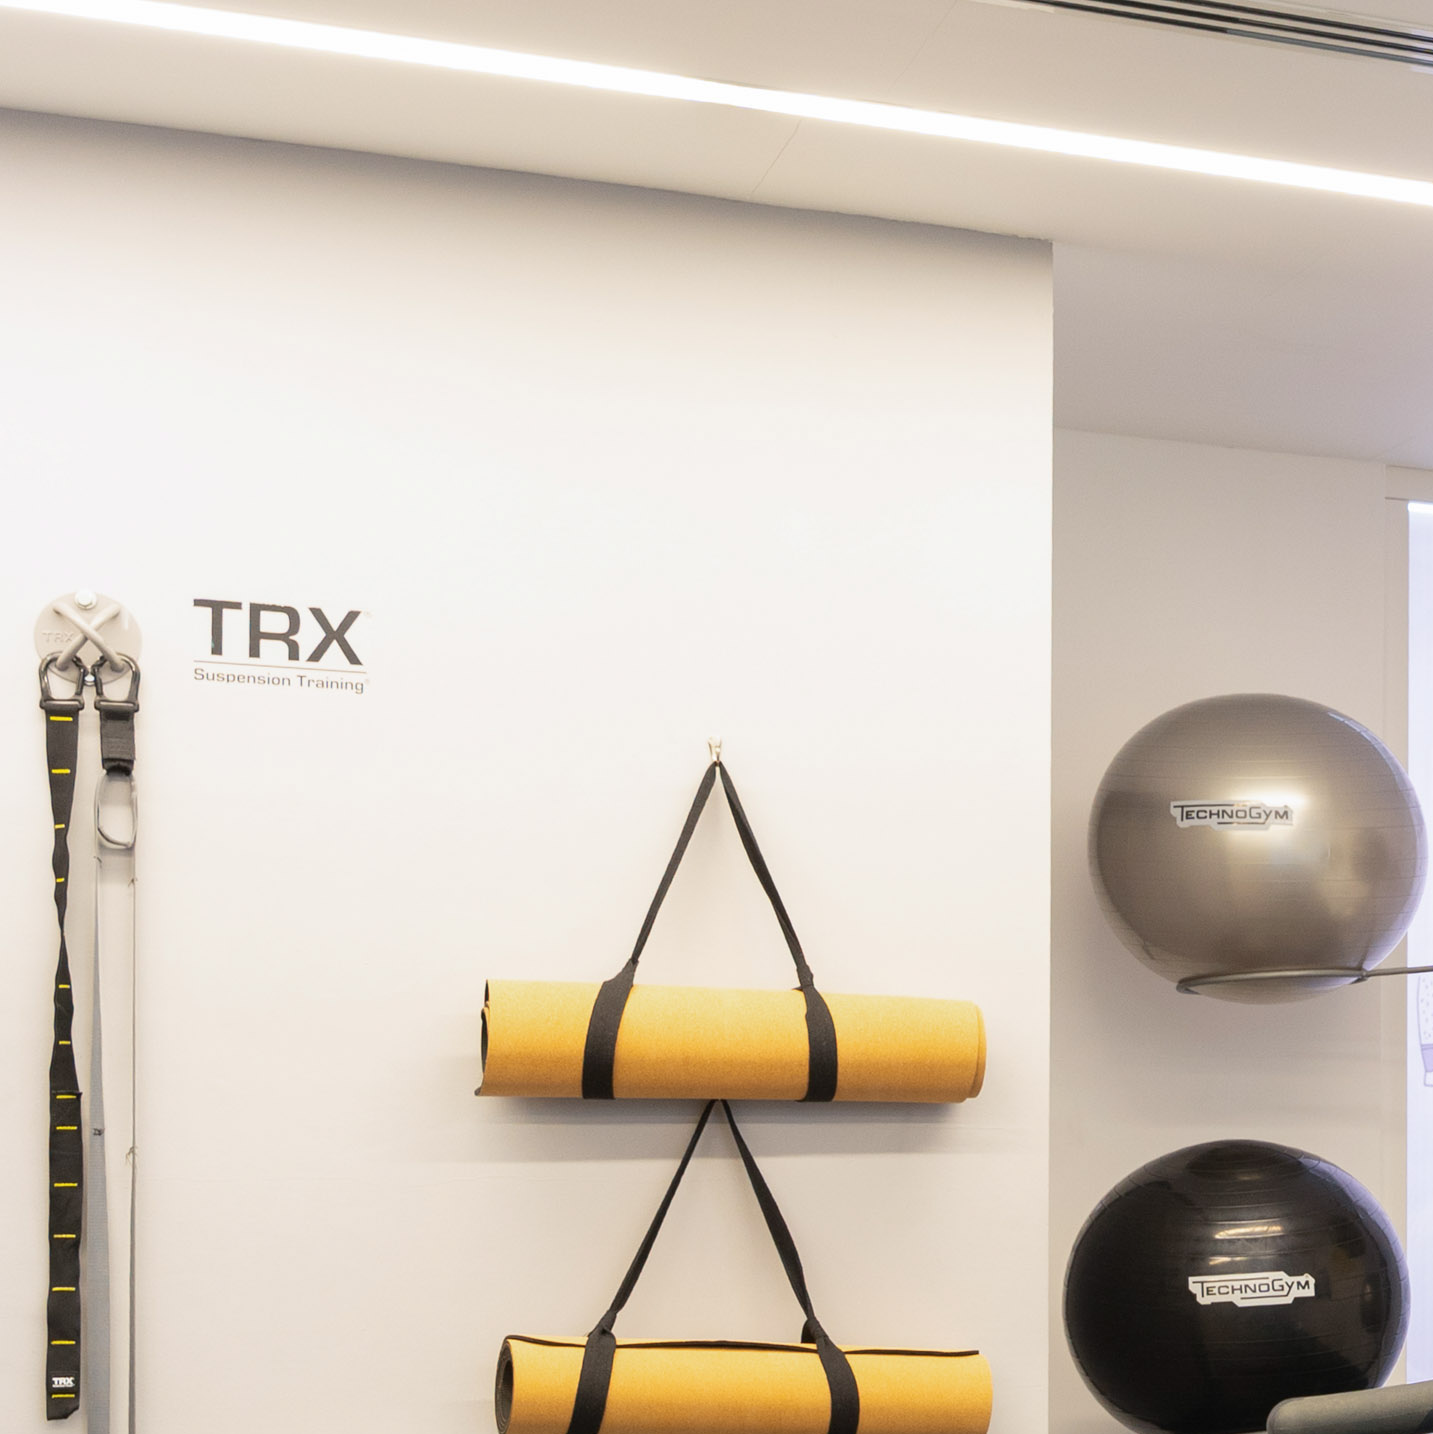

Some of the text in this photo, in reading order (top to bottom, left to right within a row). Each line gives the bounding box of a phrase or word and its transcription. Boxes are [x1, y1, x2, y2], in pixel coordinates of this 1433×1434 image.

[193, 598, 364, 666] TRX
[194, 668, 365, 695] Suspension Training
